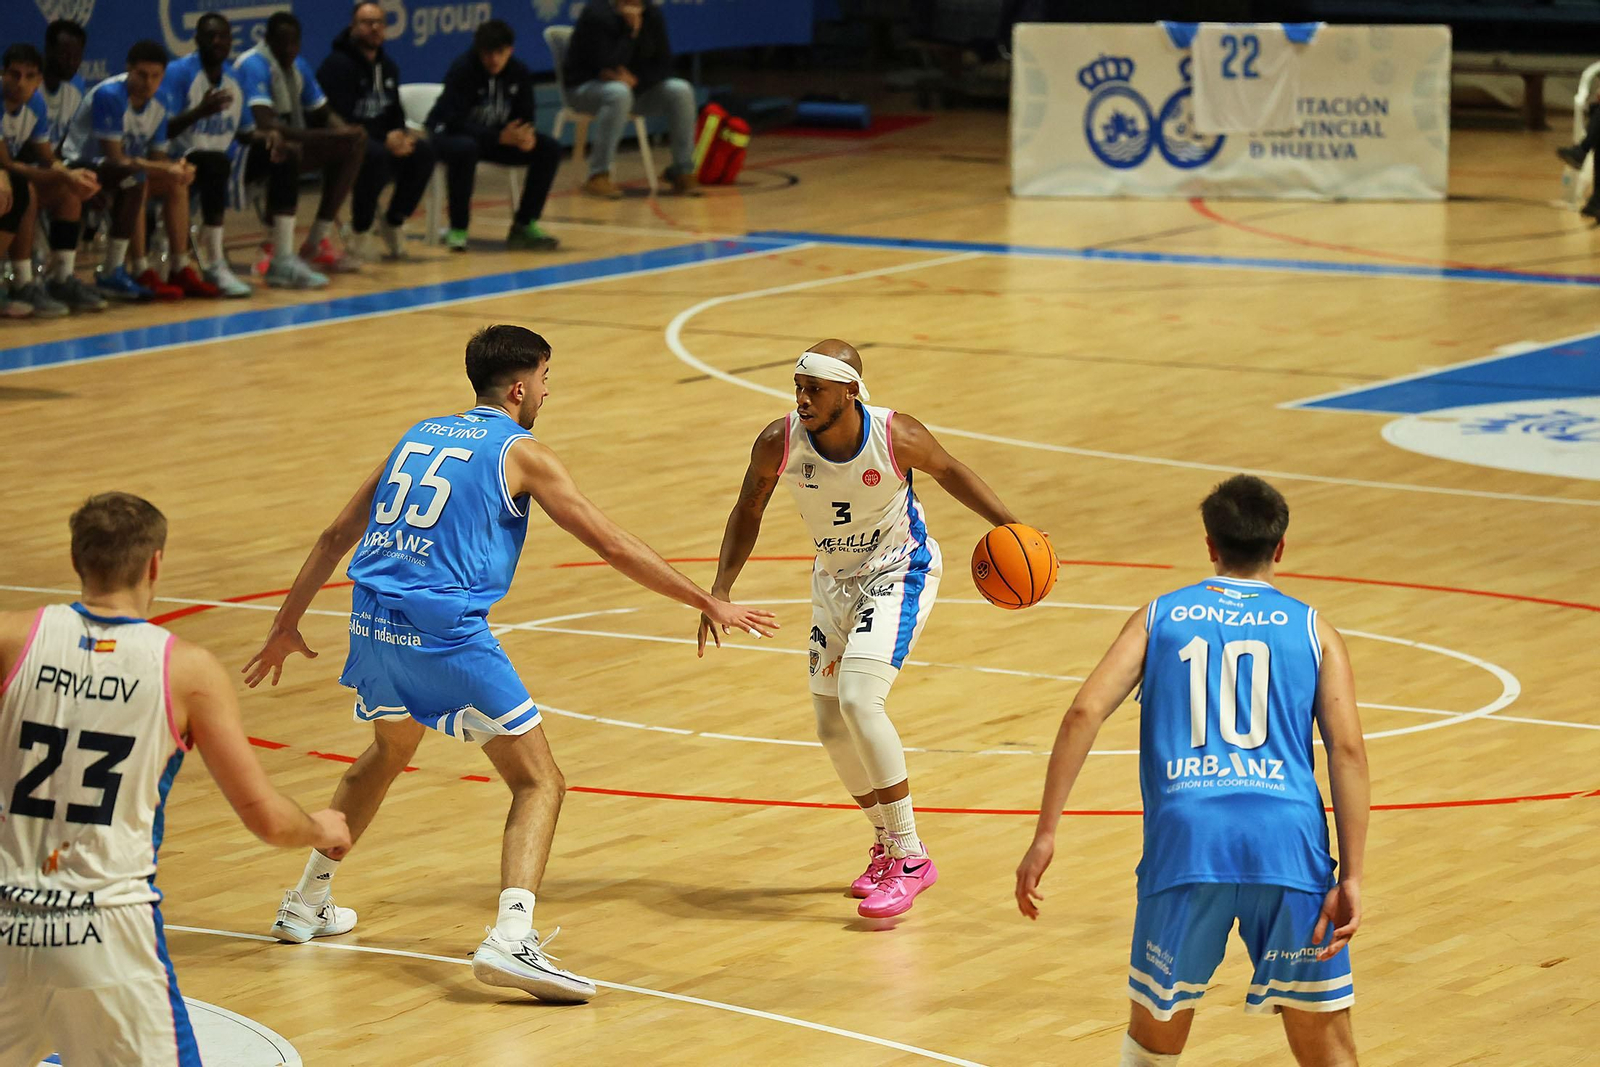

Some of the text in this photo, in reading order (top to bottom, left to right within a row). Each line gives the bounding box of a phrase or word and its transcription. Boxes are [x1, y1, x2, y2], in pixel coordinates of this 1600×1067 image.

[412, 2, 491, 46] group
[1220, 34, 1260, 79] 22
[1297, 95, 1388, 116] TACIÓN
[1271, 142, 1358, 160] HUELVA
[419, 422, 488, 440] TREVIÑO
[375, 441, 474, 529] 55
[832, 501, 852, 526] 3
[856, 608, 875, 633] 3
[1170, 604, 1289, 626] GONZALO
[36, 665, 139, 704] PAVLOV
[1178, 635, 1270, 749] 10
[9, 720, 136, 826] 23
[1166, 752, 1285, 781] URBANZ
[1203, 780, 1214, 788] DE
[1217, 778, 1286, 792] COOPERATIVAS
[0, 921, 102, 948] MELILLA
